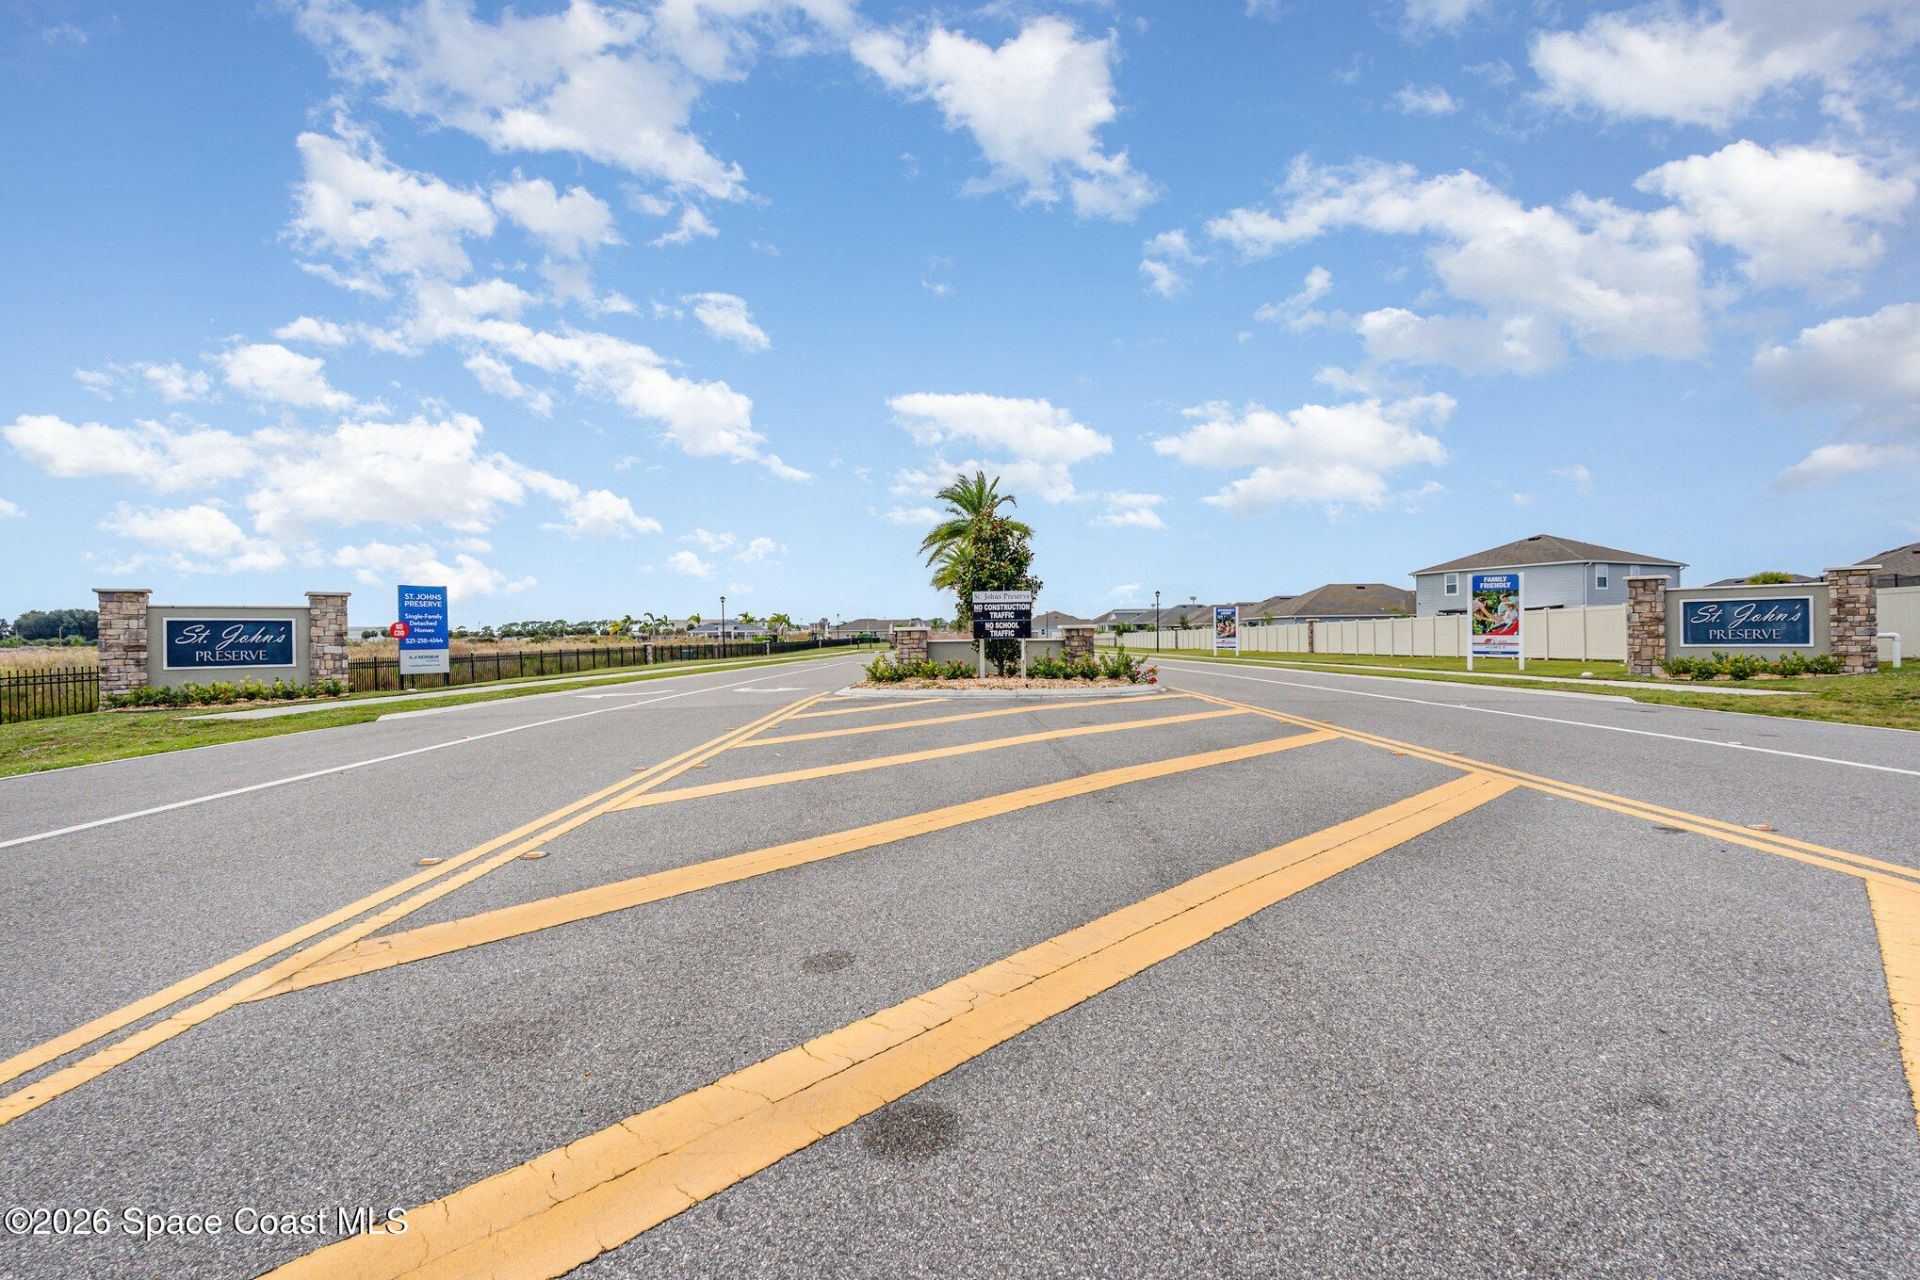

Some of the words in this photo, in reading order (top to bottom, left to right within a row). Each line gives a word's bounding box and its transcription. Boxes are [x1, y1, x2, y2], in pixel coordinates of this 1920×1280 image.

[984, 592, 1001, 600] Johns
[1003, 592, 1030, 600] Preserve
[974, 604, 982, 612] NO
[1690, 604, 1723, 624] St.
[1728, 603, 1801, 629] John's
[985, 622, 994, 630] NO
[175, 624, 211, 645] St.
[215, 624, 286, 651] John's
[1709, 628, 1780, 640] PRESERVE
[195, 649, 268, 662] PRESERVE
